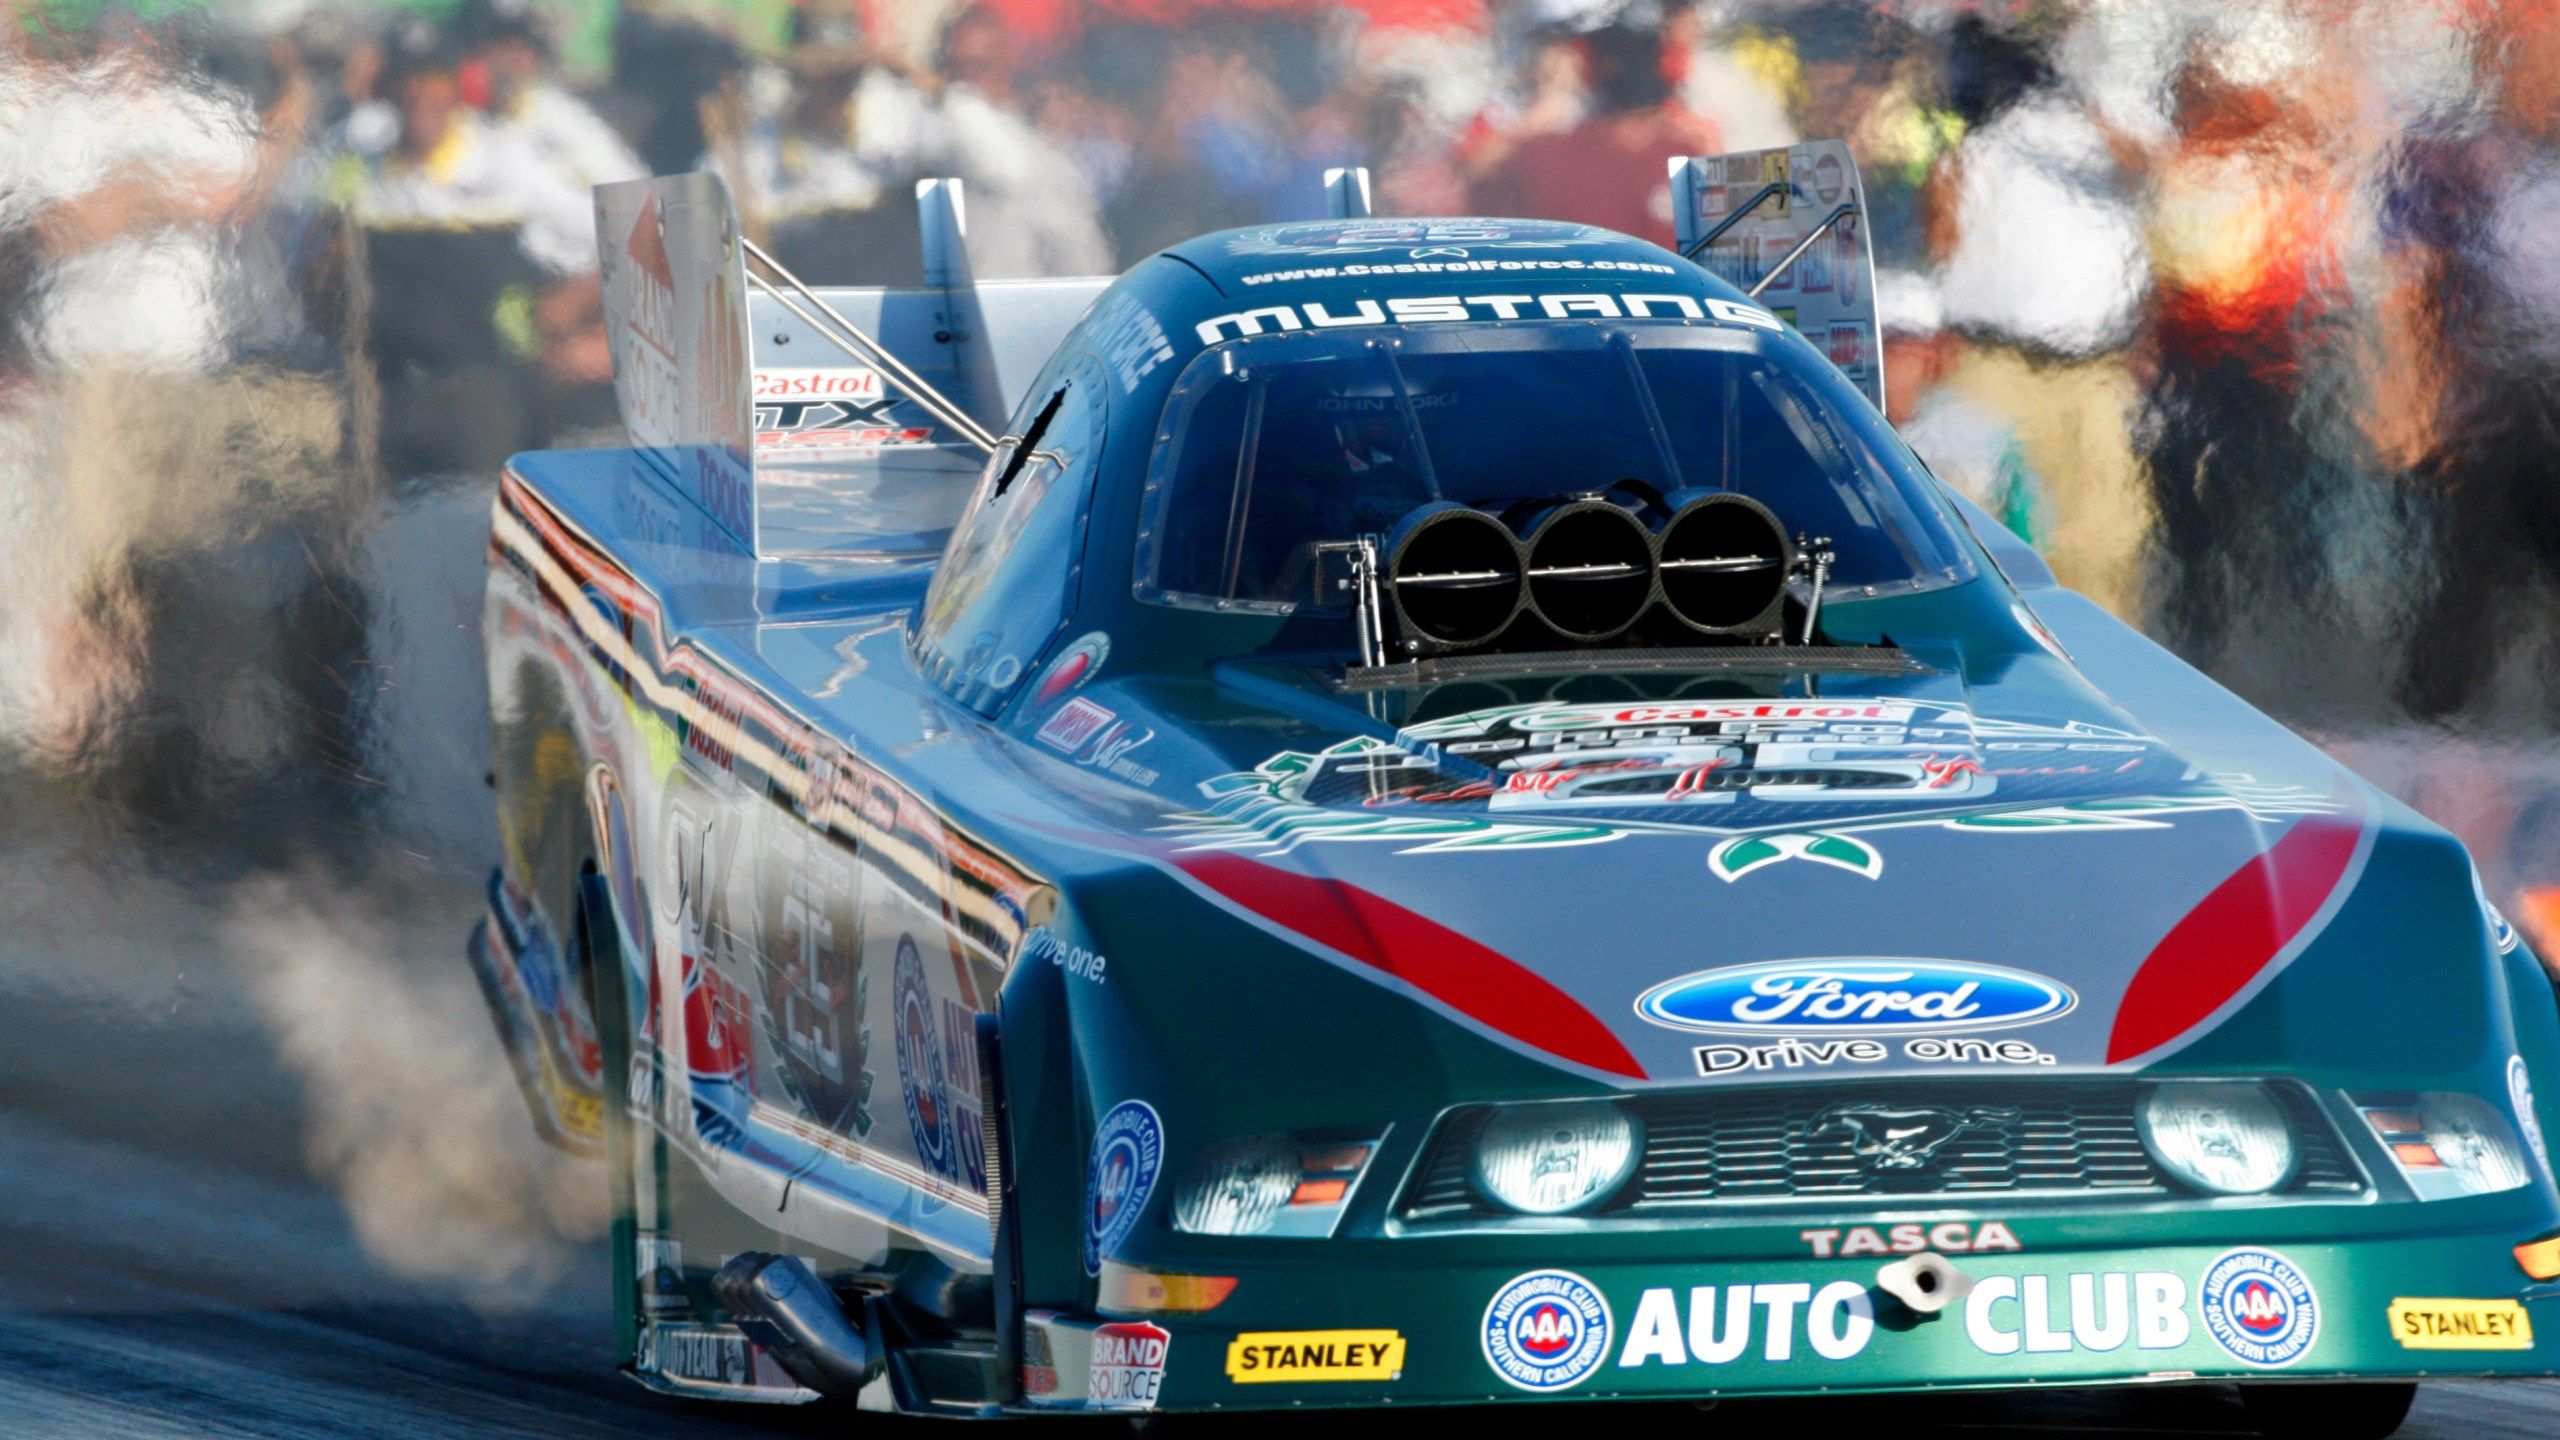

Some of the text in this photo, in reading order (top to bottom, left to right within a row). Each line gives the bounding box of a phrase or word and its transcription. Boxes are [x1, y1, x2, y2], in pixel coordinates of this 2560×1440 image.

[1241, 258, 1677, 287] www.CastrolForce.com
[1196, 294, 1784, 346] MUSTANG
[754, 373, 876, 396] Castrol
[1613, 702, 1892, 722] Castrol
[1068, 946, 1106, 984] one.
[1732, 970, 1983, 1021] Ford
[1693, 1037, 2056, 1077] Drive one.
[1802, 1221, 2022, 1258] TASCA
[2207, 1254, 2306, 1298] AUTOMOBILE CLUB
[1493, 1277, 1601, 1321] AUTOMOBILE CLUB
[2234, 1289, 2287, 1321] AAA
[1518, 1312, 1575, 1343] AAA
[1618, 1271, 2192, 1368] AUTO CLUB
[2206, 1303, 2314, 1361] SOUTHERN CALIFORNIA
[2402, 1312, 2517, 1339] STANLEY
[1092, 1337, 1164, 1367] BRAND
[1241, 1342, 1390, 1371] STANLEY
[1489, 1325, 1605, 1384] SOUTHERN CALIFORNIA
[1090, 1370, 1160, 1402] SOURCE
